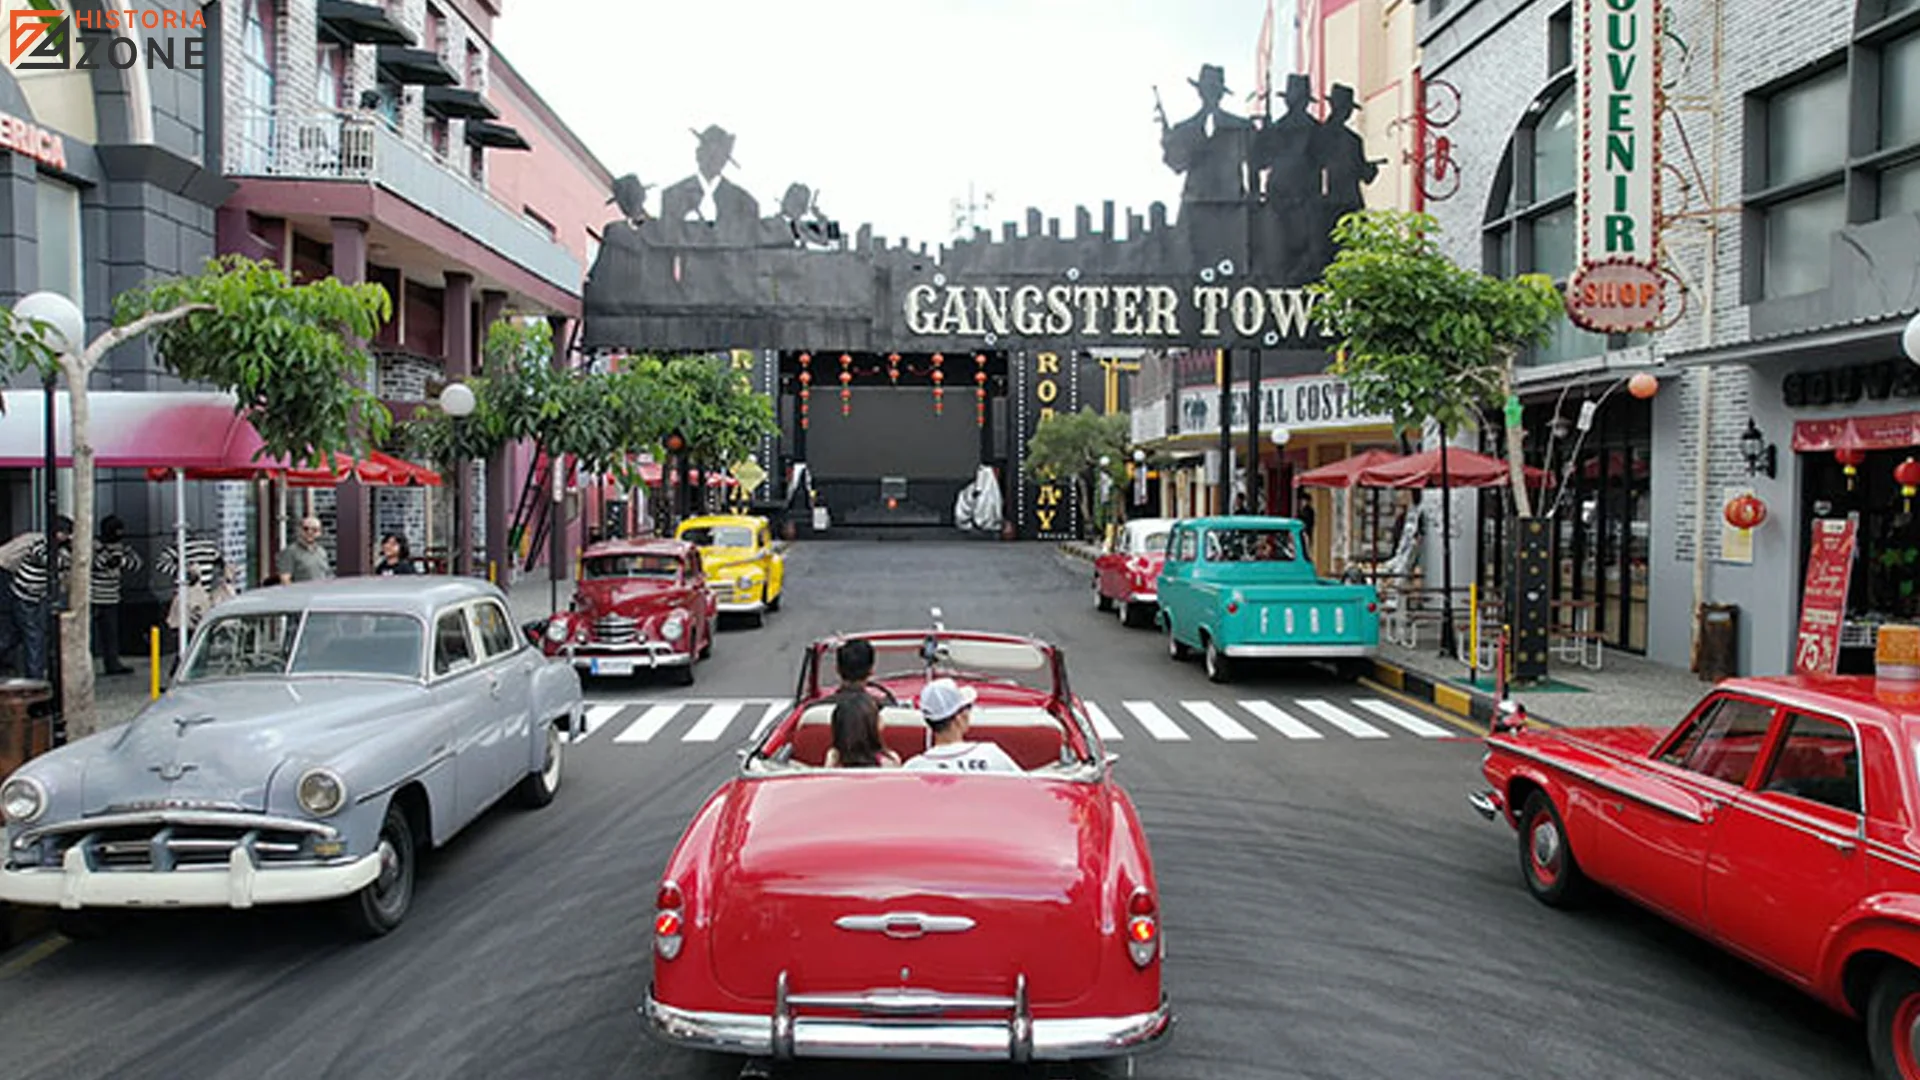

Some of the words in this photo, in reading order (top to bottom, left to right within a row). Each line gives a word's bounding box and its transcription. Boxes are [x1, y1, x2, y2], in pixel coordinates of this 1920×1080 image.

[903, 284, 1181, 336] GANGSTER
[1582, 280, 1656, 309] SHOP
[1036, 352, 1062, 530] ROAY
